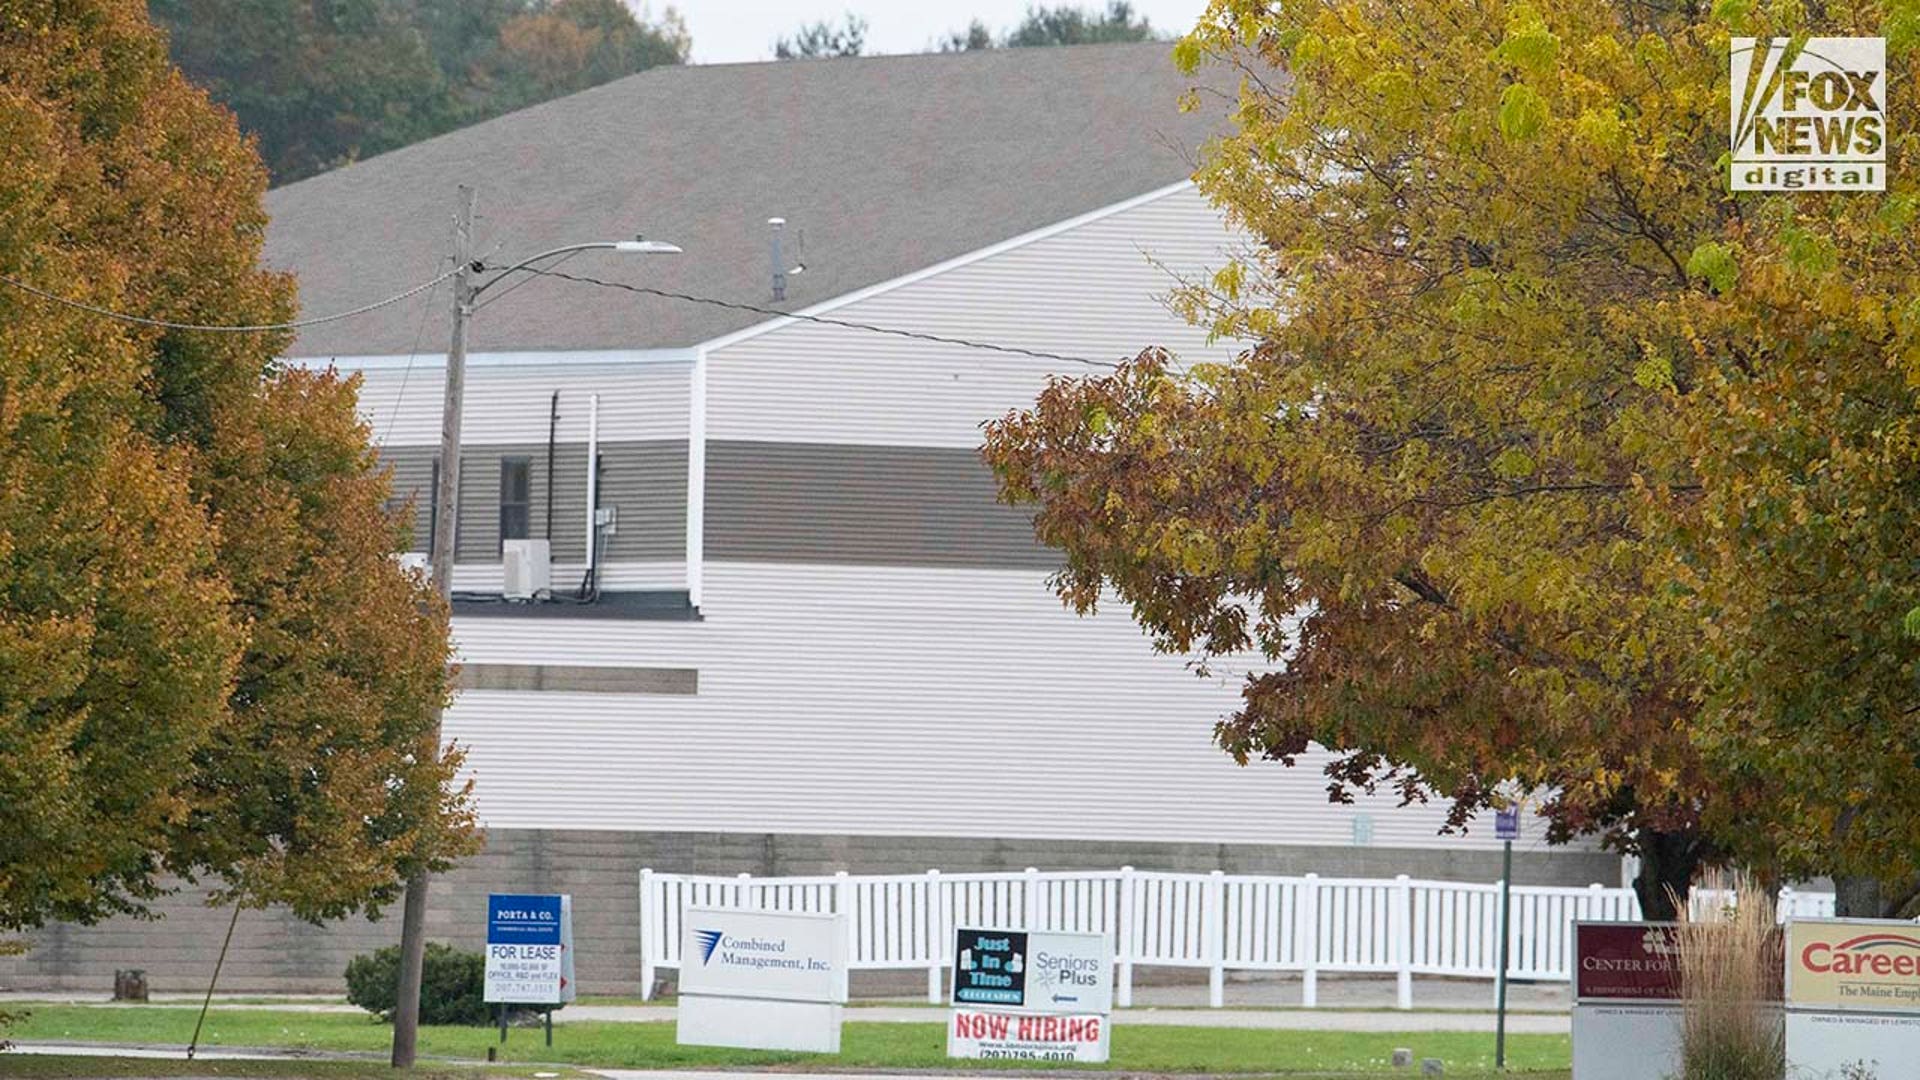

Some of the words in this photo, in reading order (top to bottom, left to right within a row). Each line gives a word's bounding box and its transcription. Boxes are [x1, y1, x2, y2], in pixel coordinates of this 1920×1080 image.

[497, 910, 528, 920] PORTA
[722, 936, 785, 953] Combined
[974, 937, 1010, 951] Just
[491, 946, 516, 959] FOR
[520, 946, 556, 960] LEASE
[721, 951, 804, 970] Management,
[807, 957, 831, 971] Inc.
[982, 955, 1000, 969] In
[1036, 952, 1099, 972] Seniors
[970, 971, 1012, 987] Time
[1060, 970, 1097, 987] Plus
[1840, 985, 1857, 997] The
[1860, 986, 1892, 998] Maine
[956, 1013, 1010, 1040] NOW
[1018, 1016, 1100, 1043] HIRING
